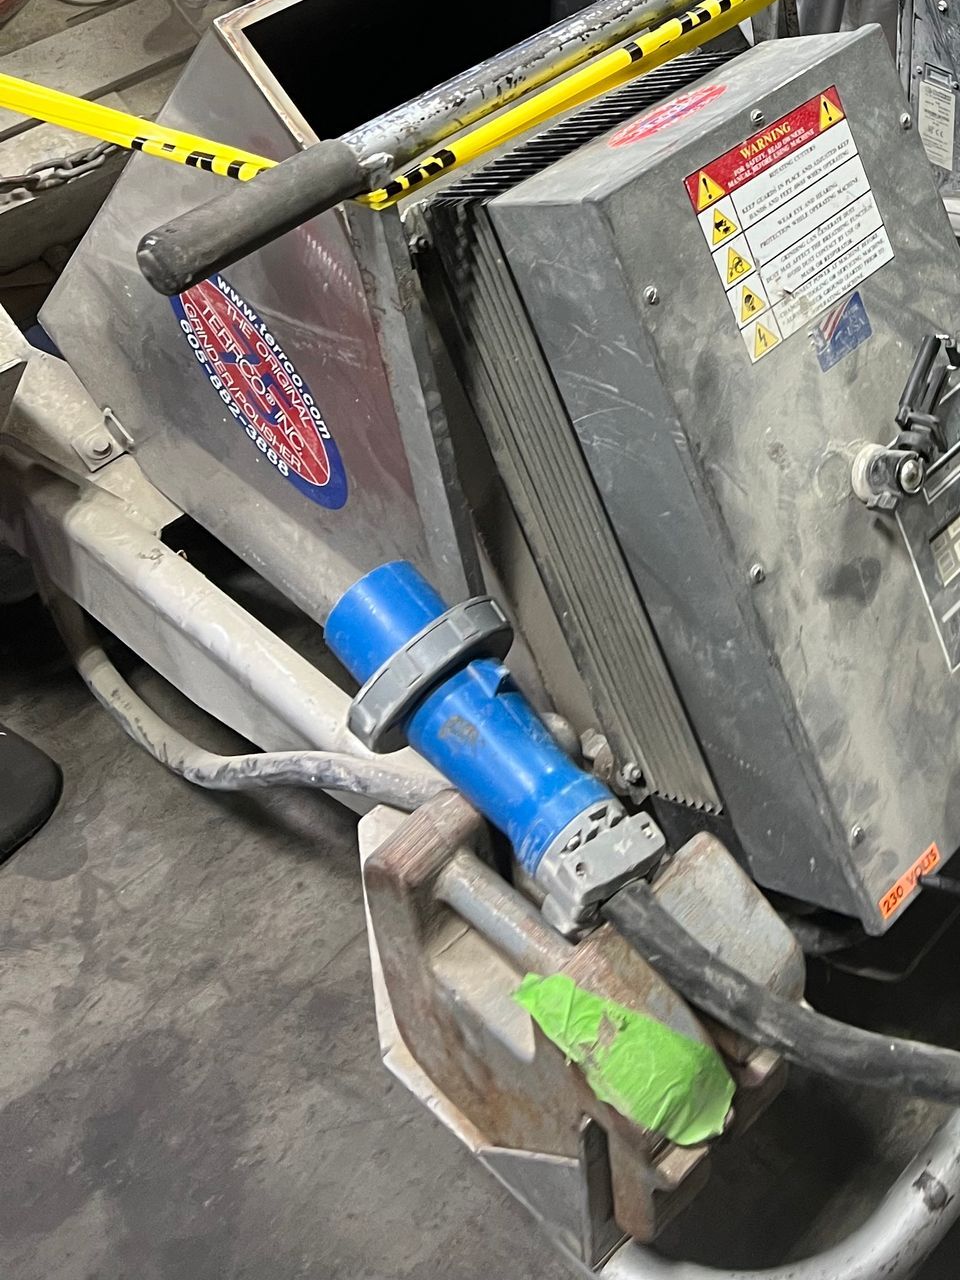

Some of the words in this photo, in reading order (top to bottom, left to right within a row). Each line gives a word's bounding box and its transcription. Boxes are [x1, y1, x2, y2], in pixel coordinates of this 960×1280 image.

[726, 167, 753, 189] MANUAL
[751, 154, 773, 173] BEFORE
[772, 143, 790, 159] USING
[789, 127, 815, 148] MACHINE
[732, 164, 745, 177] FOR
[766, 140, 783, 155] READ
[738, 119, 791, 161] WARNING
[768, 158, 793, 179] ROTATING
[793, 143, 816, 162] CUTTERS
[741, 201, 756, 214] KEEP
[755, 187, 777, 205] GUARDS
[776, 181, 785, 191] IN
[784, 171, 800, 186] PLACE
[800, 163, 812, 175] AND
[836, 138, 850, 151] KEEP
[748, 203, 767, 220] HANDS
[767, 195, 780, 207] AND
[779, 186, 793, 199] FEET
[806, 166, 822, 181] WHEN
[822, 148, 849, 170] OPERATING
[759, 223, 791, 249] PROTECTION
[790, 211, 808, 227] WHILE
[808, 191, 836, 215] OPERATING
[836, 176, 858, 195] MACHINE
[776, 211, 792, 226] WEAR
[792, 204, 803, 215] EYE
[803, 196, 815, 208] AND
[815, 180, 837, 200] HEARING
[779, 241, 806, 263] GRINDING
[805, 233, 817, 245] CAN
[816, 215, 842, 237] GENERATE
[791, 247, 811, 265] AFFECT
[810, 240, 821, 251] THE
[821, 219, 849, 243] BREATHING
[849, 203, 873, 224] FUNCTION
[801, 254, 815, 268] DUST
[814, 238, 837, 259] CONTACT
[812, 267, 830, 284] POWER
[837, 245, 860, 265] MACHINE
[860, 232, 878, 249] BEFORE
[815, 259, 823, 268] OR
[823, 237, 853, 262] RESPIRATOR
[217, 276, 331, 439] www.terrco.com
[224, 300, 253, 339] THE
[256, 341, 312, 428] ORIGINAL
[180, 319, 290, 477] 605-882-3888
[184, 303, 302, 472] GRINDER/POLISHER
[274, 411, 305, 457] INC.
[883, 885, 904, 914] 230
